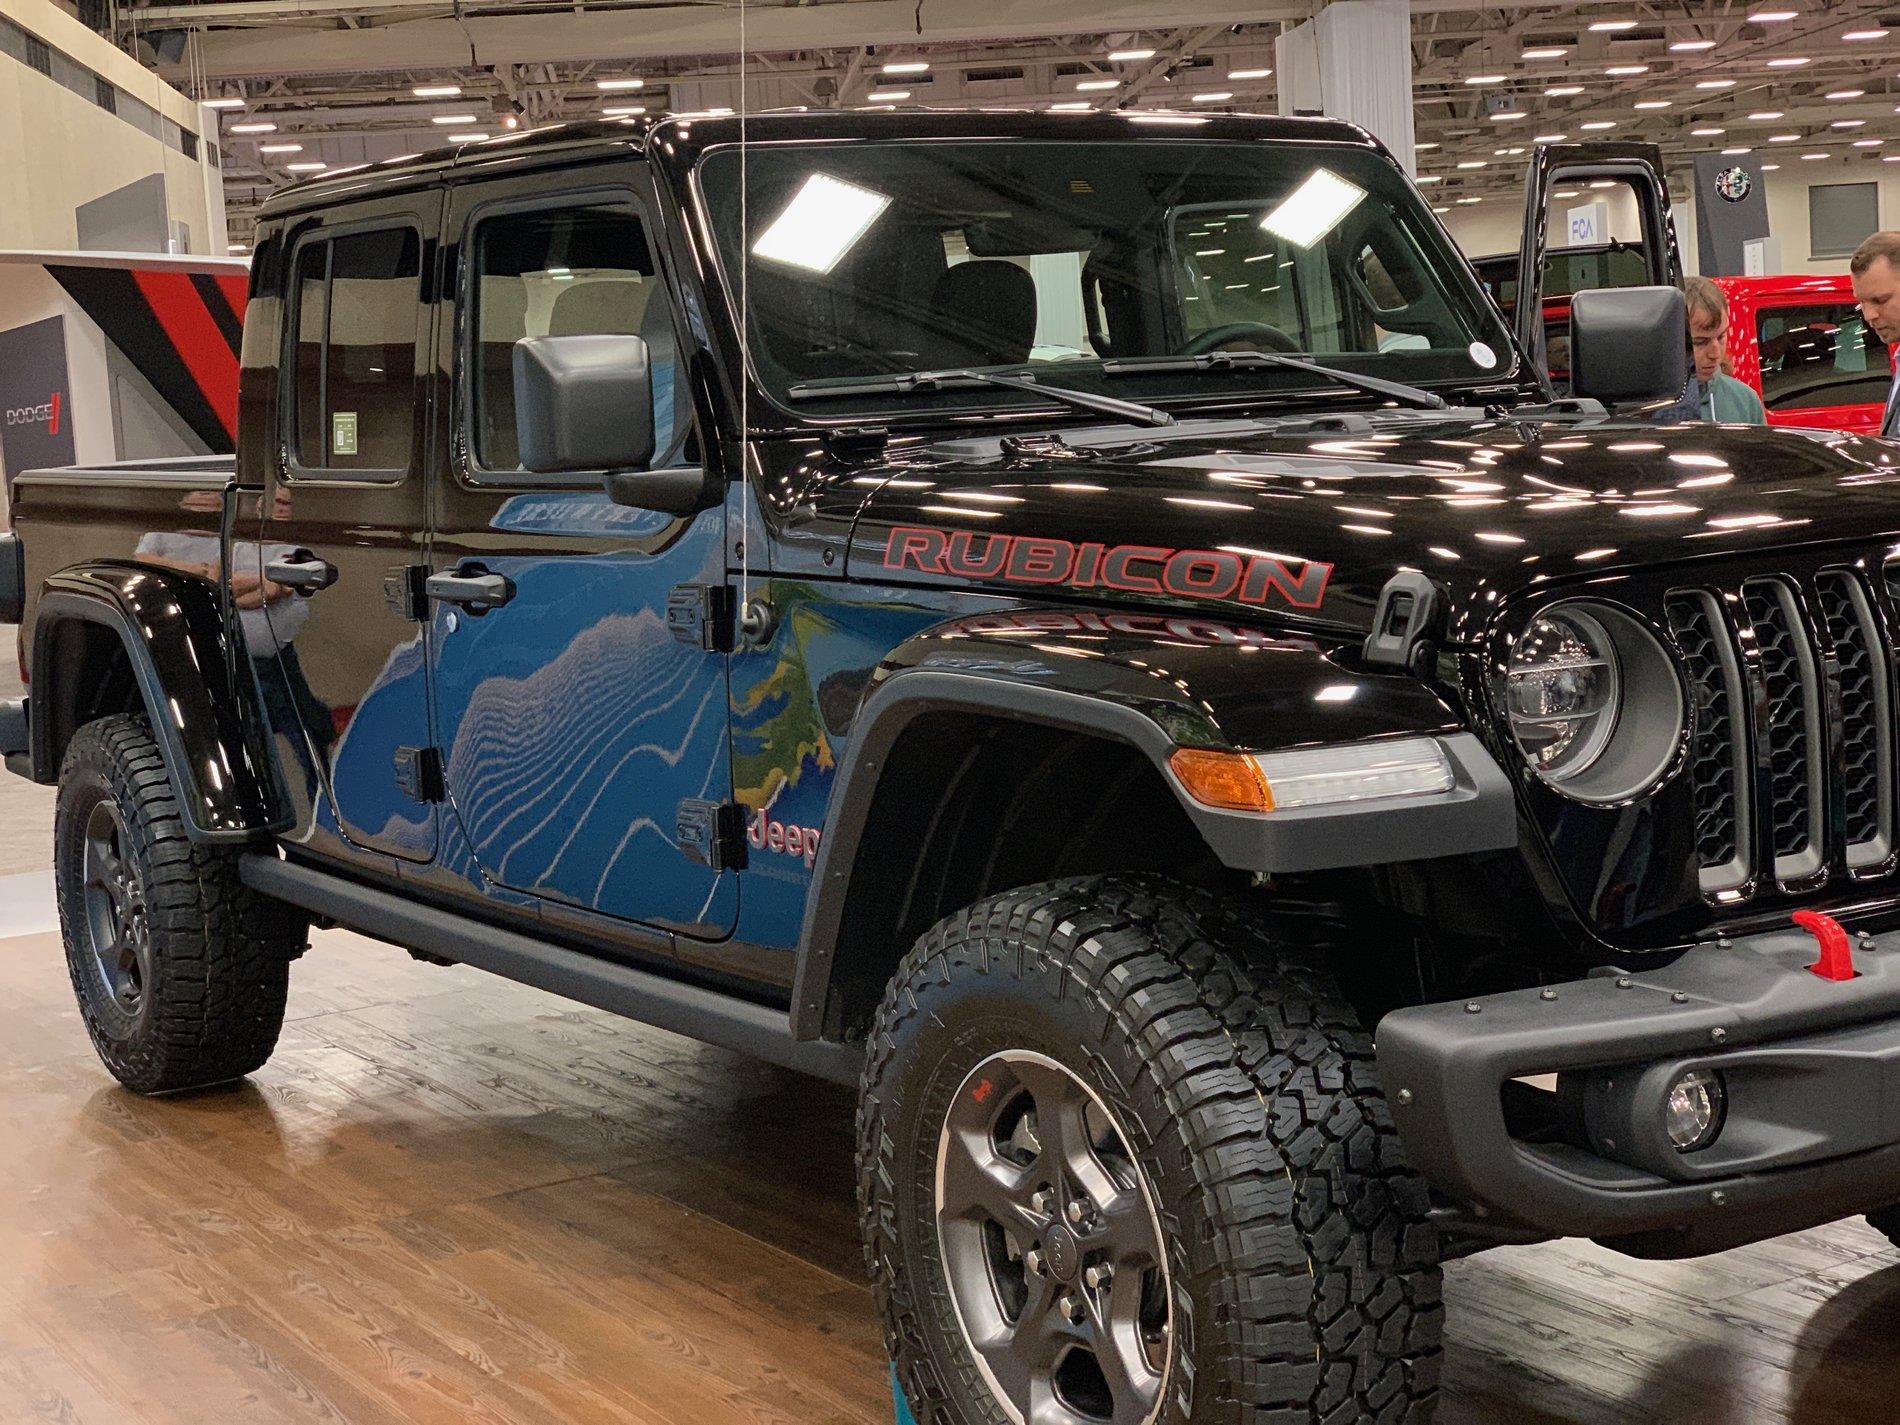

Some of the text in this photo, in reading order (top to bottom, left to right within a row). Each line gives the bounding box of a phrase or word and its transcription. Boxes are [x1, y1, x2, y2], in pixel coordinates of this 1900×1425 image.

[1572, 218, 1594, 240] FCA
[6, 403, 55, 425] DODGE
[884, 527, 1334, 608] RUBICON
[746, 807, 820, 869] Jeep
